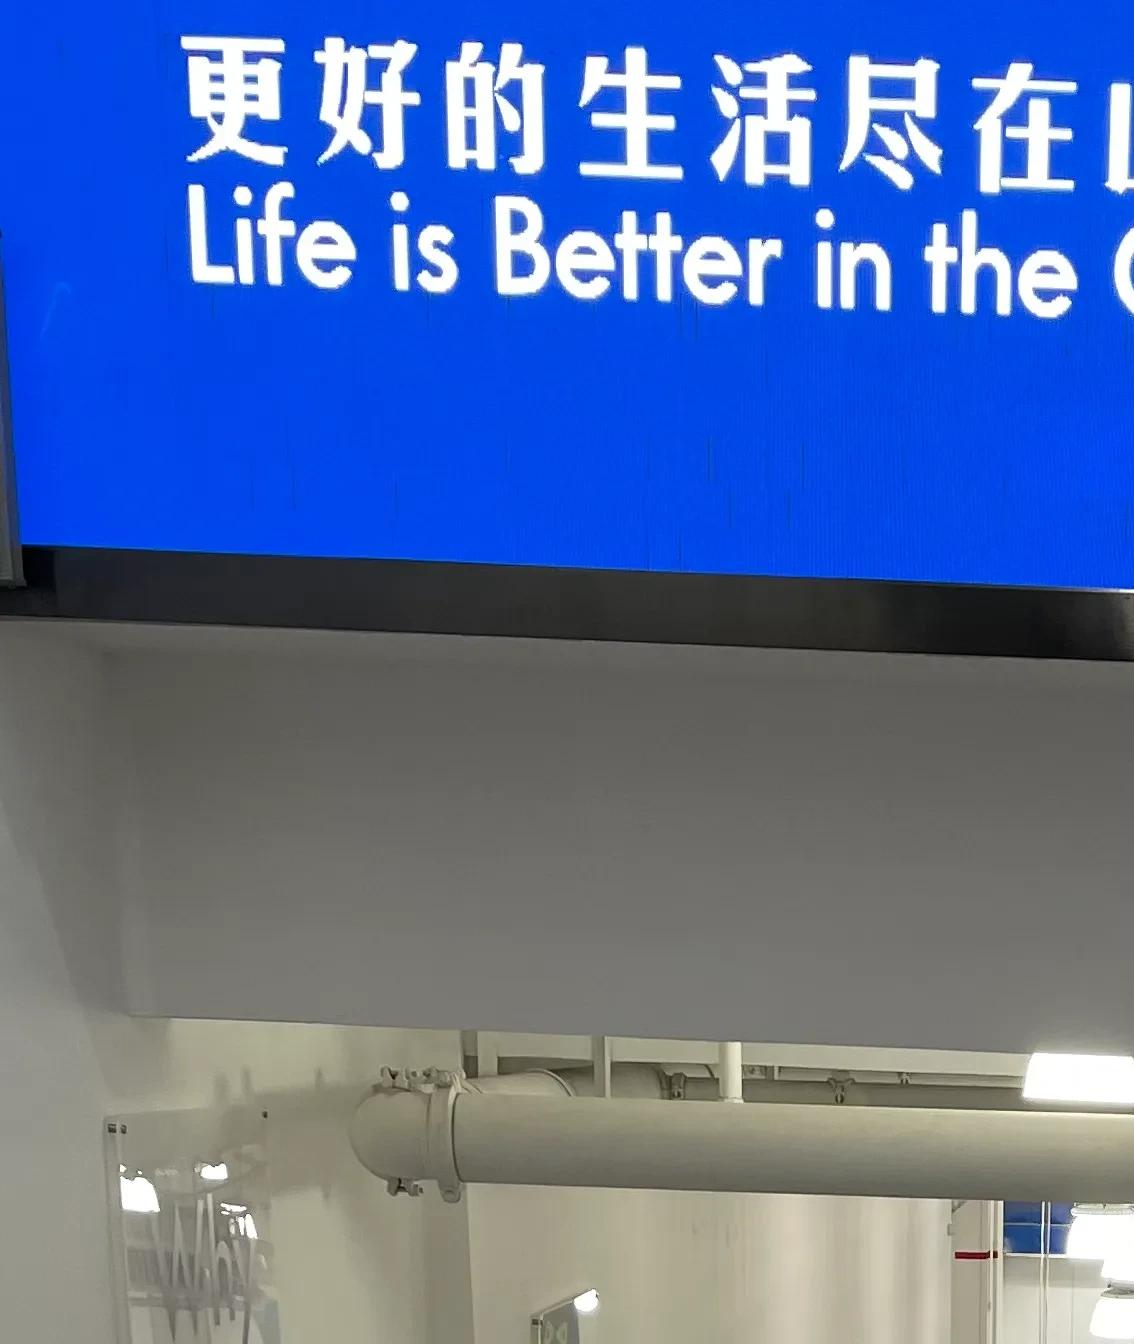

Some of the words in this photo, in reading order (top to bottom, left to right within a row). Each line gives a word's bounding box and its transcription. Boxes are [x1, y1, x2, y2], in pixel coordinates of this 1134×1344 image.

[187, 181, 357, 290] Life
[389, 191, 460, 294] is
[494, 195, 784, 307] Better
[815, 208, 892, 312] in
[923, 208, 1079, 319] the
